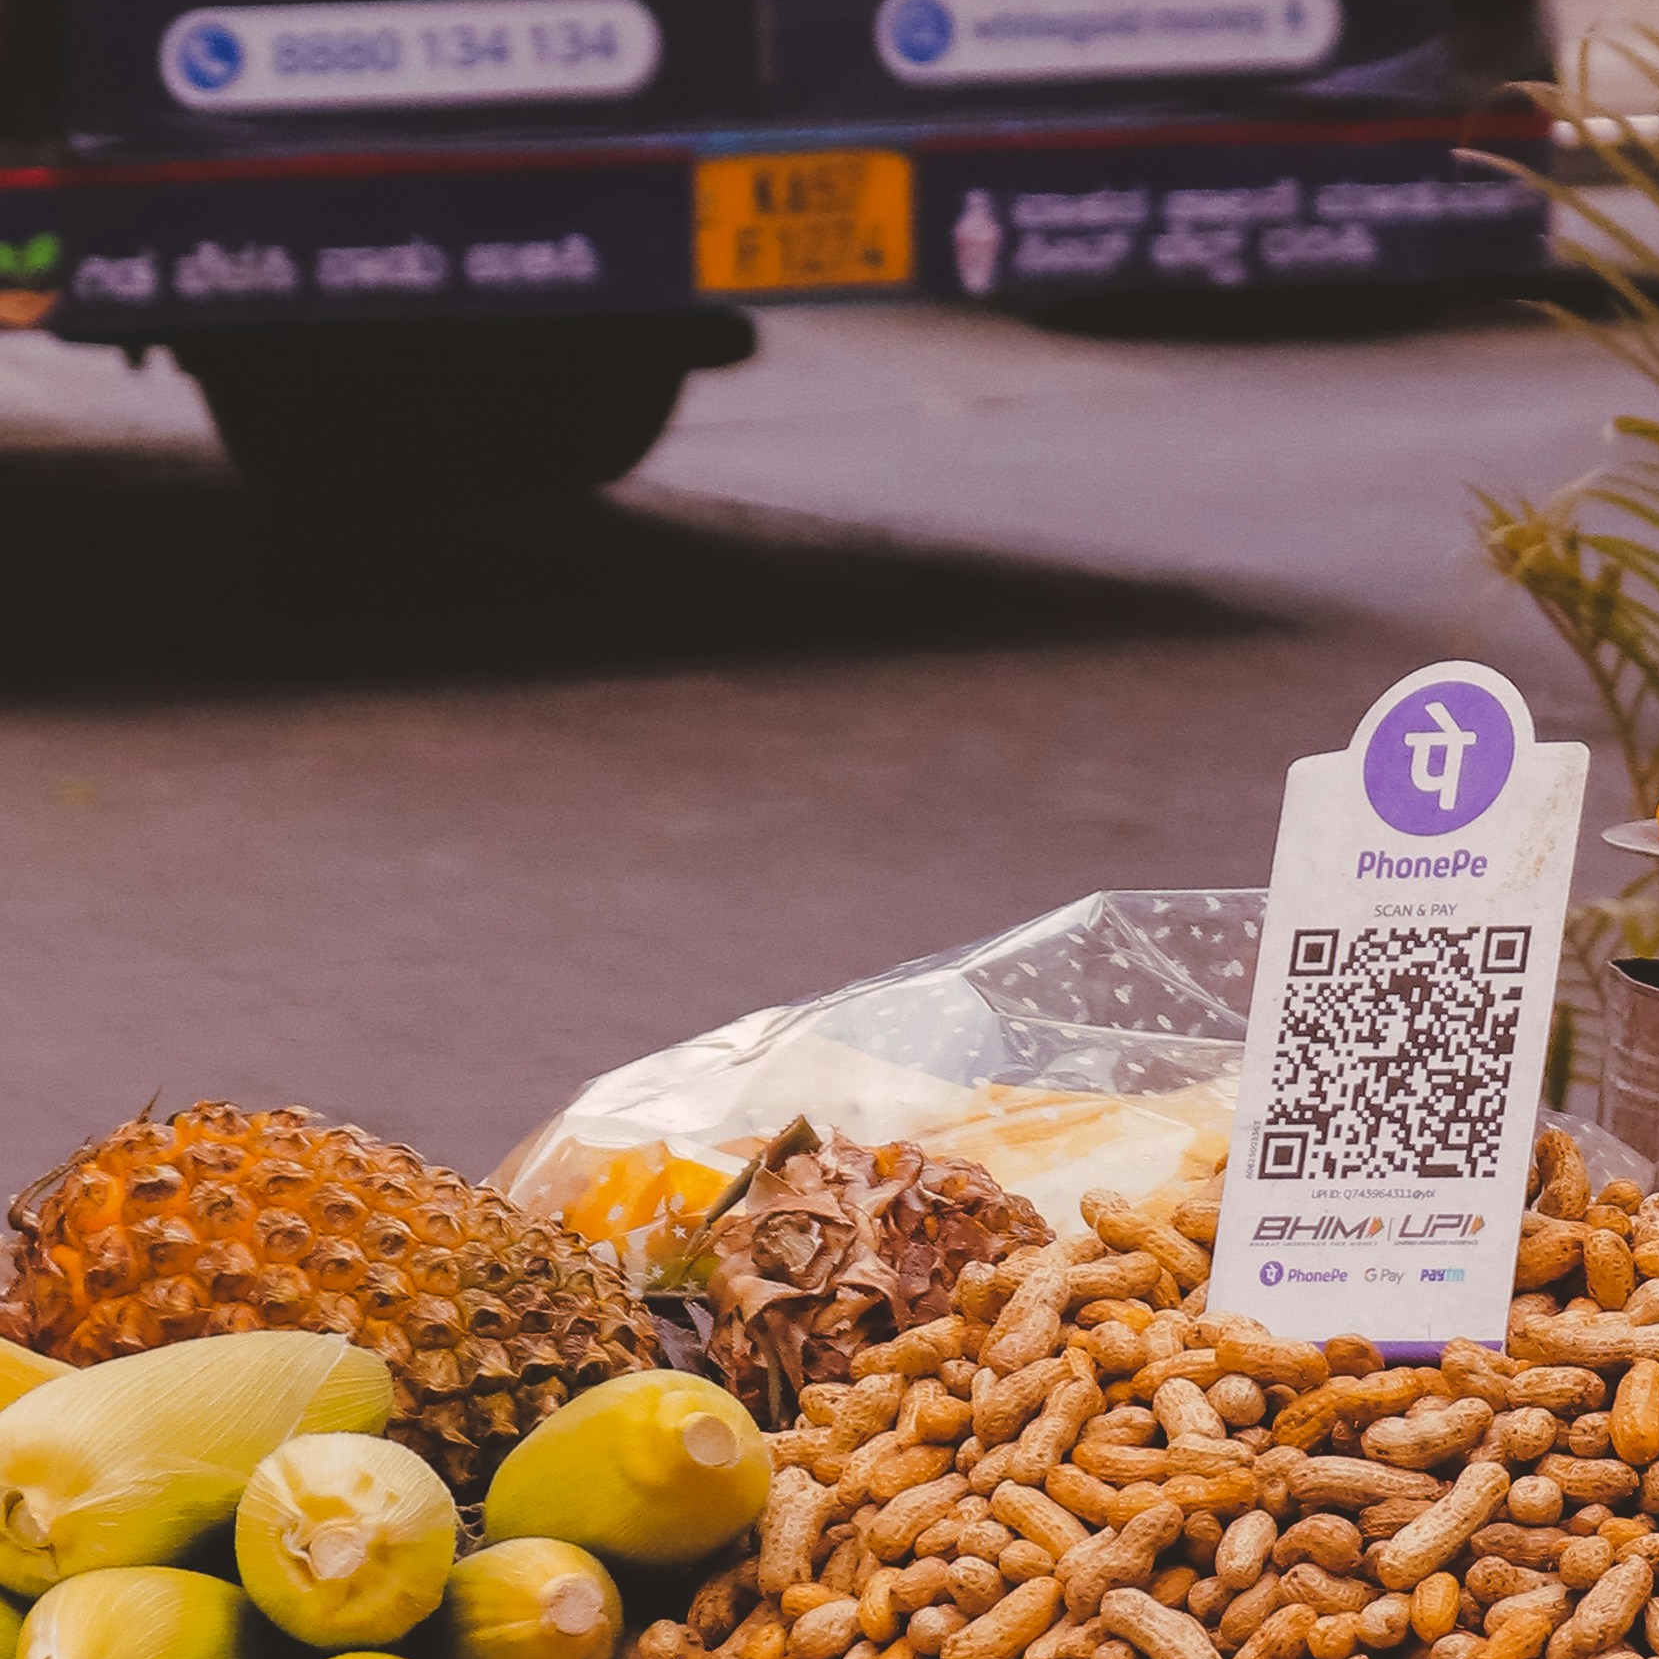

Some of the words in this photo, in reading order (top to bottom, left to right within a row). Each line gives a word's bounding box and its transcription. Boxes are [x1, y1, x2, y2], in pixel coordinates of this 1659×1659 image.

[421, 26, 507, 68] 134
[530, 19, 620, 64] 134
[1356, 849, 1488, 881] PhonePe
[1374, 903, 1412, 918] SCAN
[1416, 903, 1427, 918] &
[1430, 902, 1458, 917] PAY
[1252, 1215, 1372, 1241] BHIM
[1397, 1213, 1475, 1239] UPI
[1287, 1267, 1349, 1283] PhonePe
[1381, 1267, 1406, 1285] Pay
